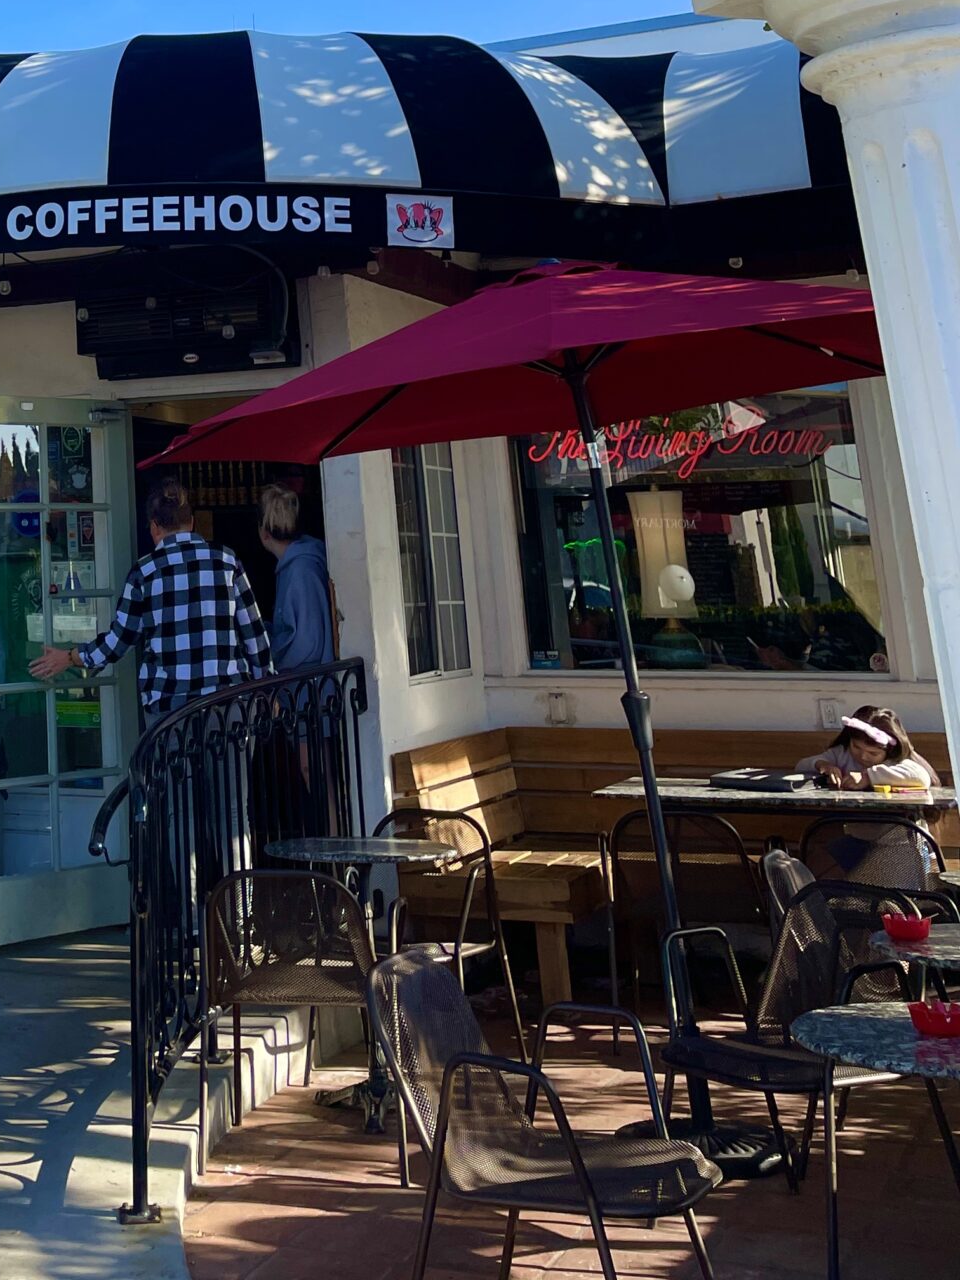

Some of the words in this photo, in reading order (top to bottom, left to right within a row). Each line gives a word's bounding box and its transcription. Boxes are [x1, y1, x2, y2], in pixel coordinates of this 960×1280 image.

[6, 194, 352, 241] COFFEEHOUSE
[598, 417, 713, 479] Living
[716, 405, 834, 456] Room
